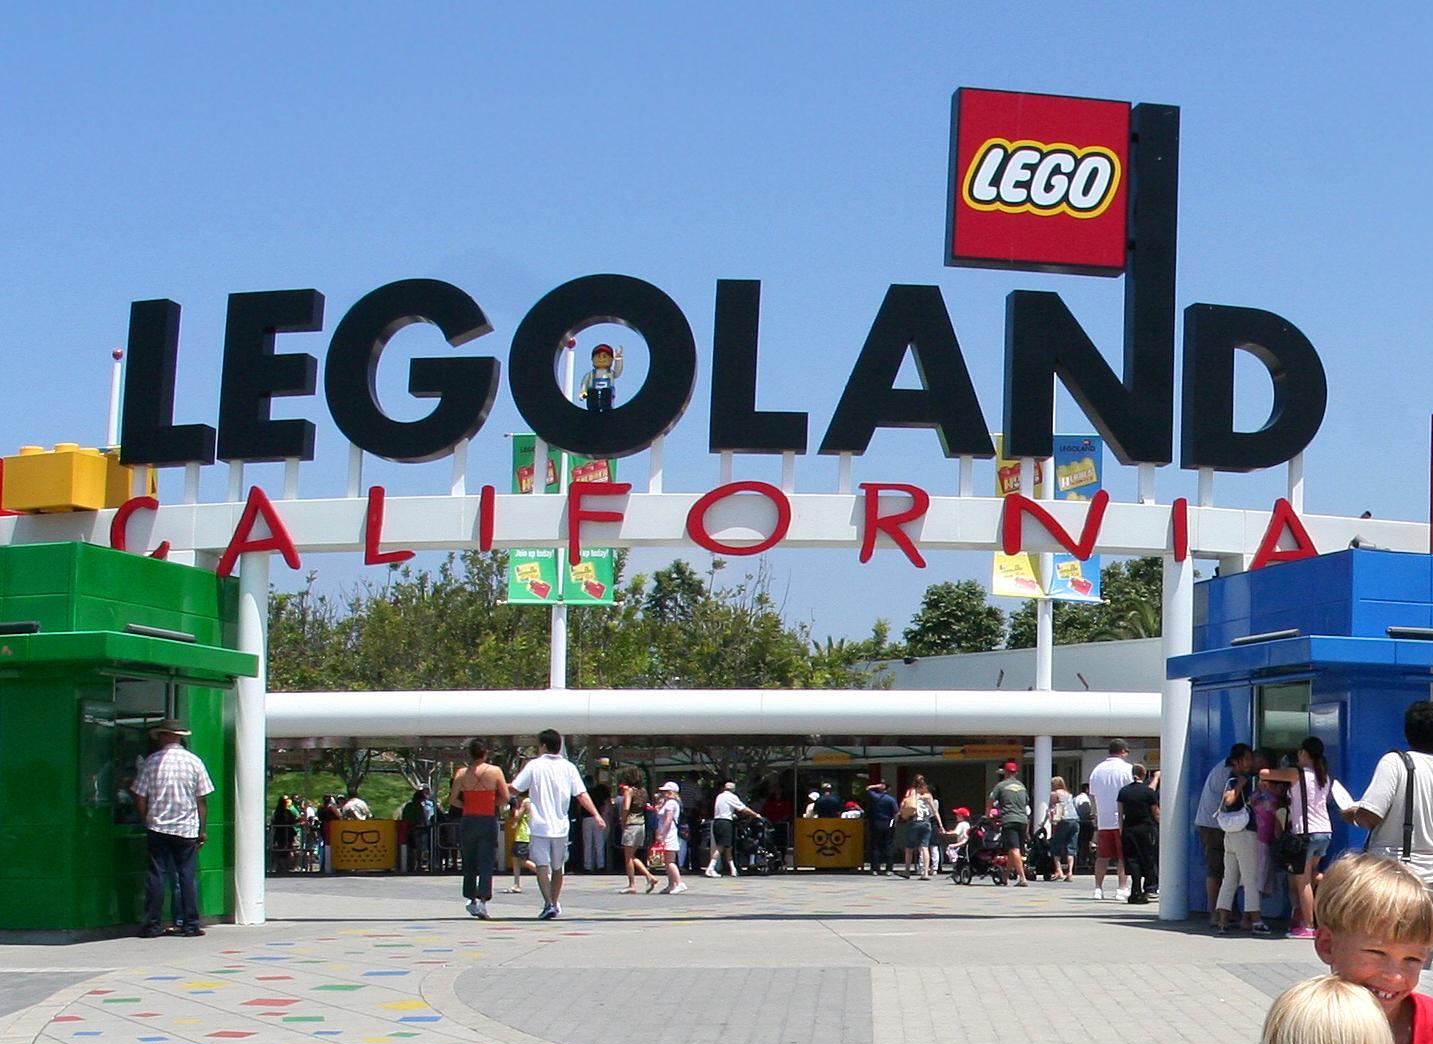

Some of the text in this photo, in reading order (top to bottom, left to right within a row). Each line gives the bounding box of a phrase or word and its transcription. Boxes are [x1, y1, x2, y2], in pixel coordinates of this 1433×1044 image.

[969, 145, 1114, 212] LEGO
[119, 103, 1328, 471] LEGOLAND
[110, 482, 1319, 577] CALIFORNIA
